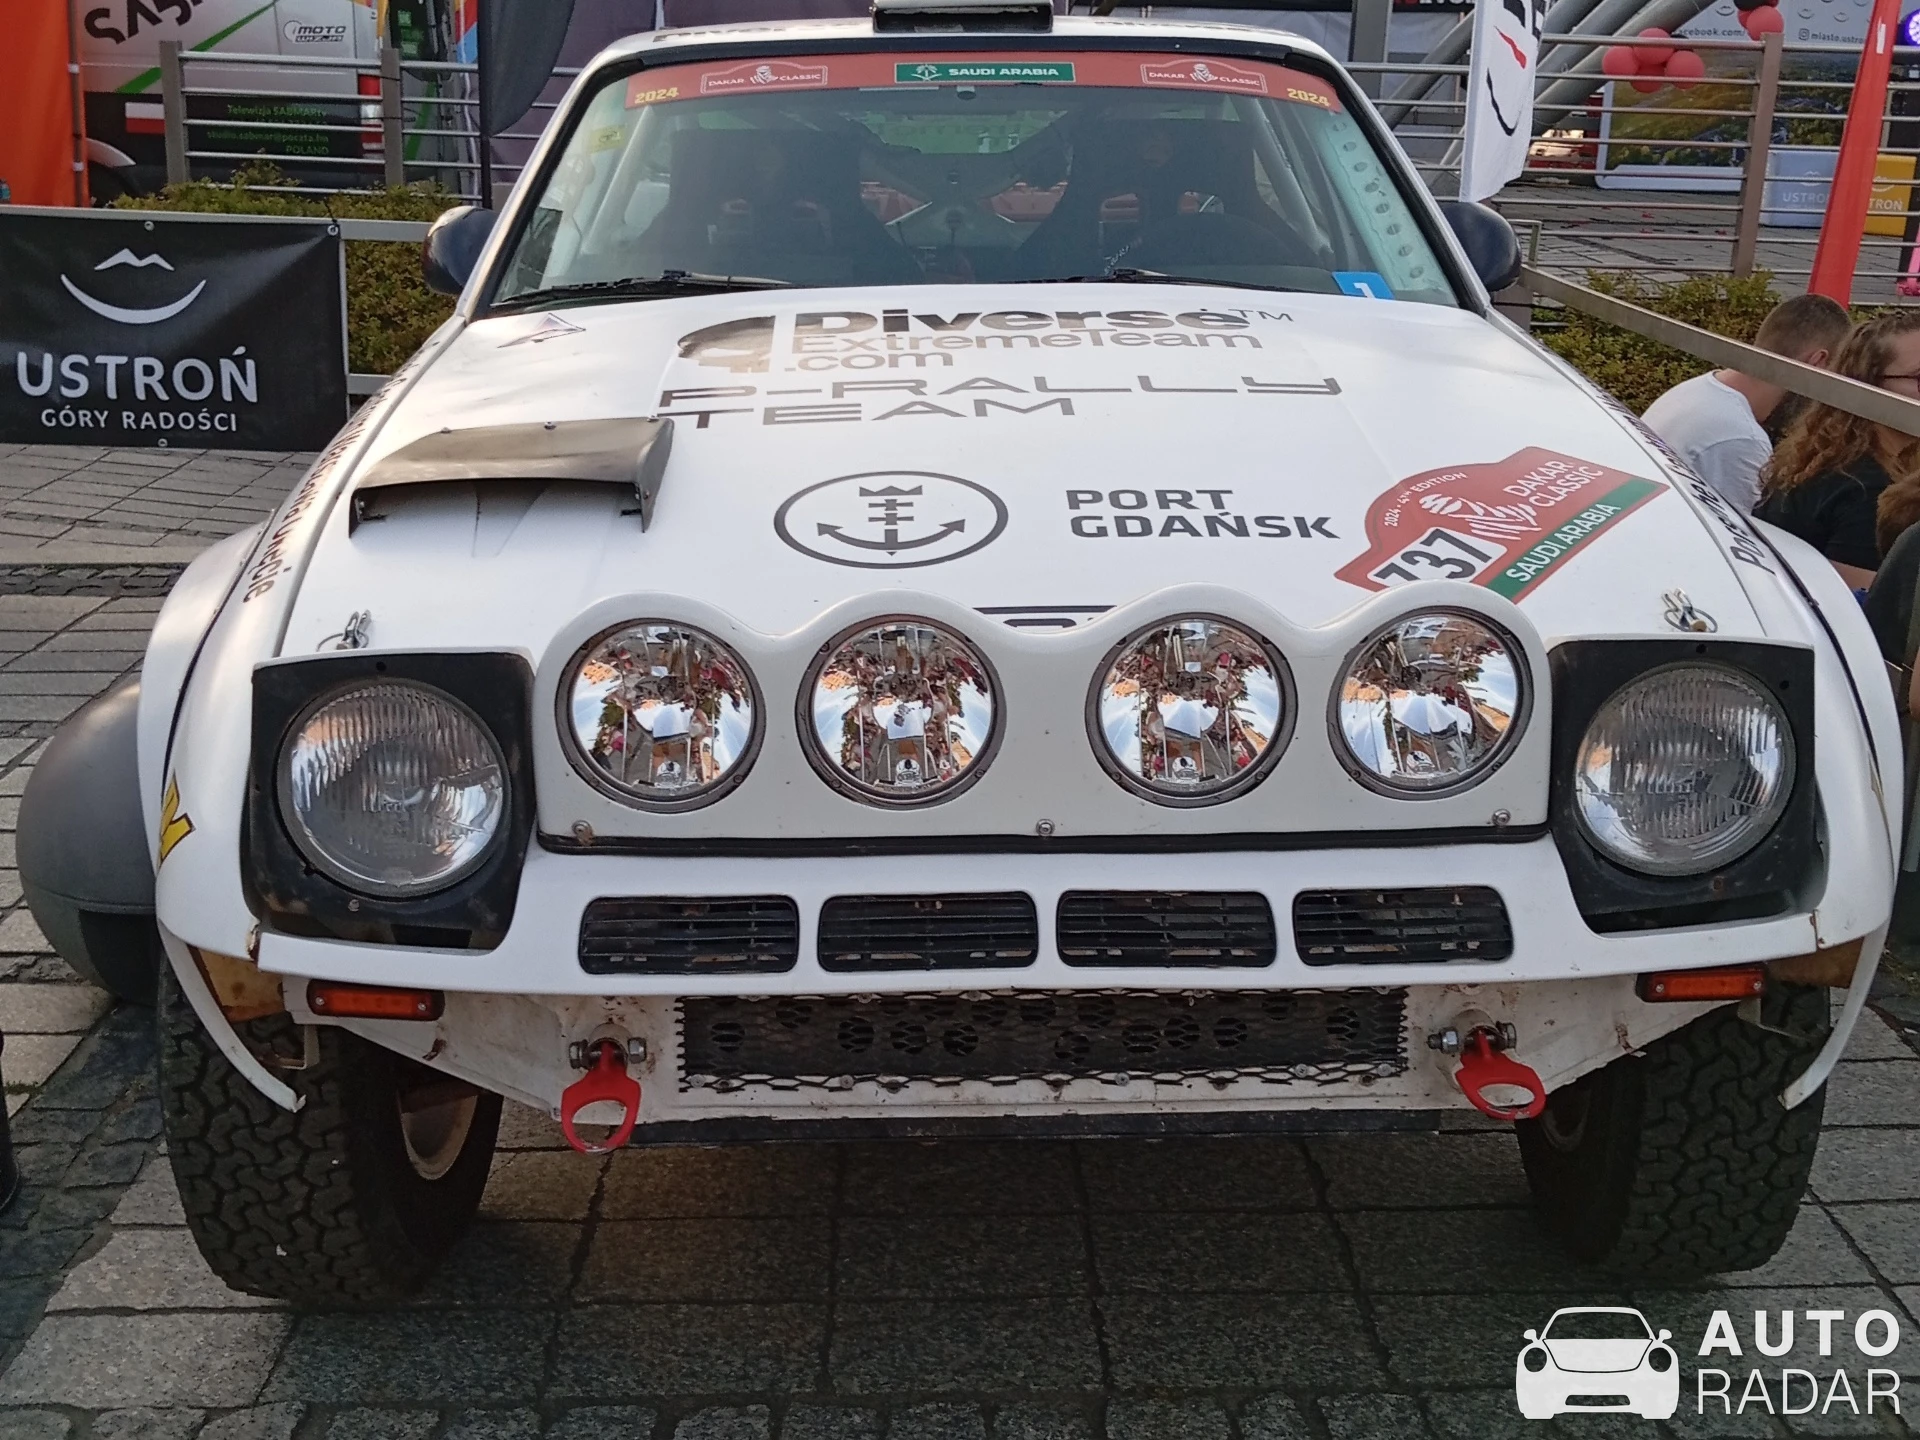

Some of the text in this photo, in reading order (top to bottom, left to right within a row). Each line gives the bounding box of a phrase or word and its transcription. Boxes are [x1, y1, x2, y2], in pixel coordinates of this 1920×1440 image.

[298, 26, 346, 34] MOTO
[1811, 32, 1864, 44] miasto.ustro
[708, 73, 822, 87] DAKAR CLASSIC
[948, 68, 1059, 76] SAUDI ARABIA
[1219, 76, 1260, 86] CLASSIC
[634, 87, 680, 104] 2024
[1286, 87, 1330, 107] 2024
[286, 145, 329, 155] POLAND
[1782, 192, 1828, 203] USTRO
[796, 309, 1250, 336] Diverse
[792, 329, 1263, 354] ExtremeTeam
[784, 352, 954, 371] .com
[17, 346, 258, 403] USTROŃ
[41, 405, 237, 432] GÓRY RADOŚCI
[657, 398, 1075, 429] TEAM
[1409, 472, 1468, 492] EDITION
[1502, 460, 1575, 497] DAKAR
[1528, 466, 1604, 507] CLASSIC
[1066, 489, 1233, 510] PORT
[1070, 511, 1341, 539] GDAŃSK
[1505, 503, 1622, 582] SAUDI ARABIA
